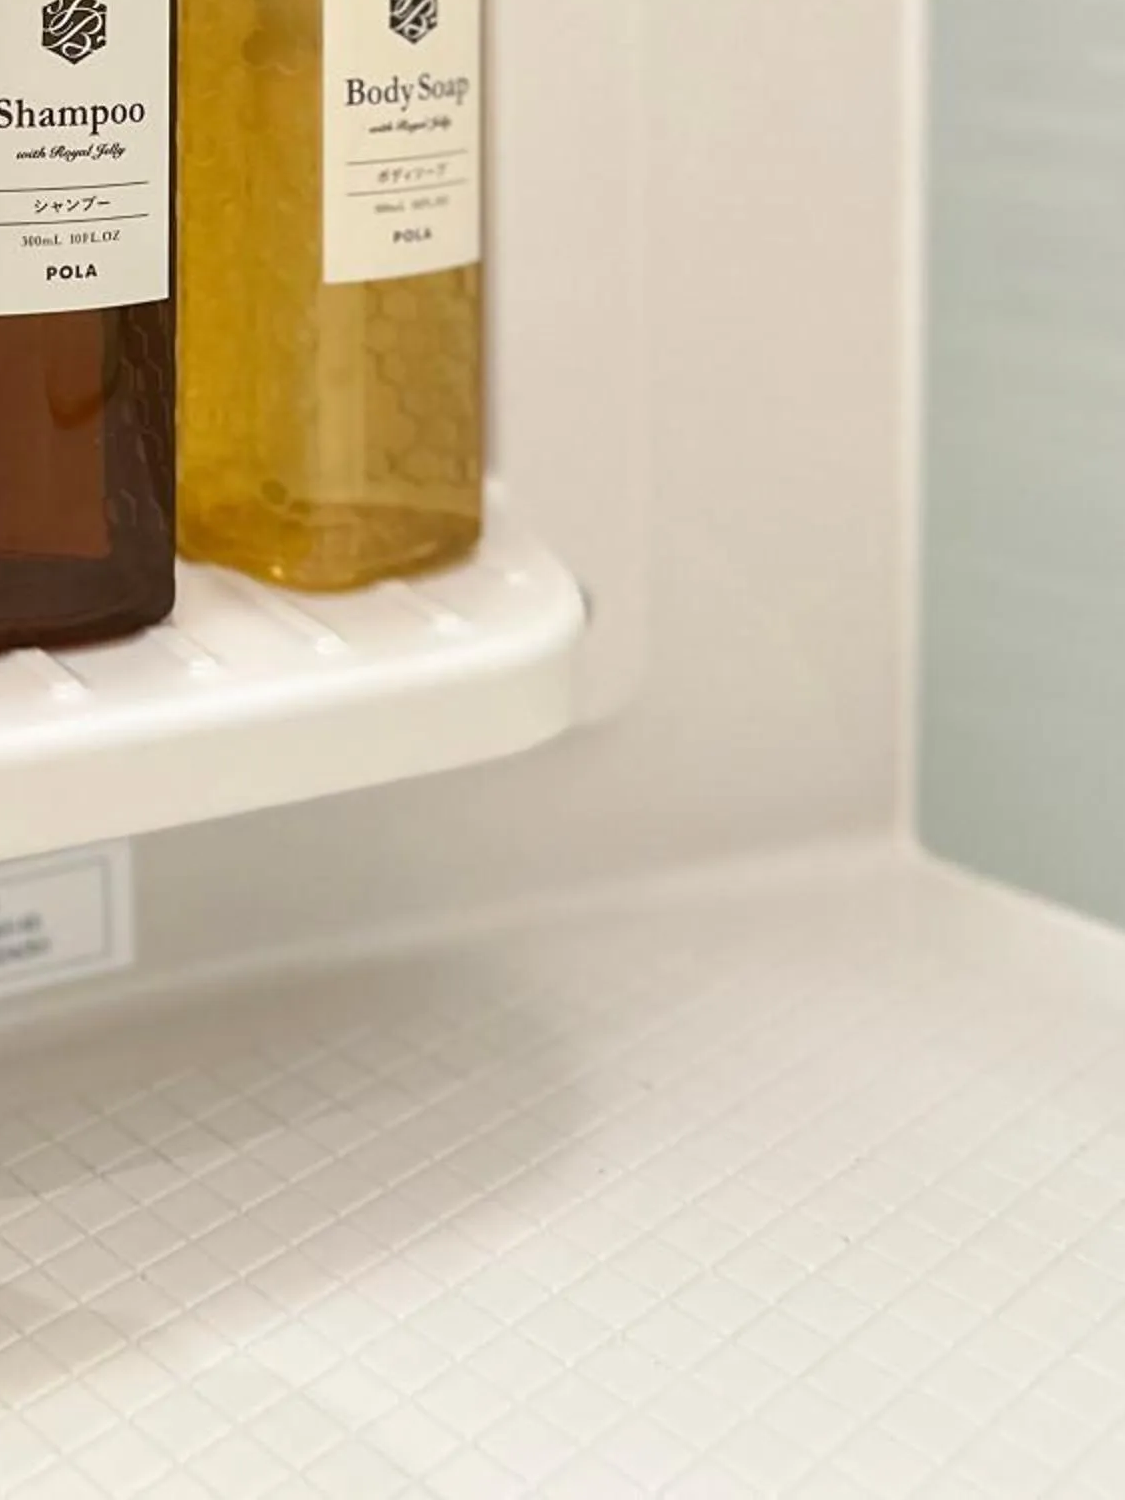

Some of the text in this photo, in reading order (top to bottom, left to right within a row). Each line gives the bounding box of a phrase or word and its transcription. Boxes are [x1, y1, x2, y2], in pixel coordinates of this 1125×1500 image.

[345, 71, 470, 112] Body Soap
[15, 142, 126, 163] with Royal Jelly
[33, 195, 111, 214] シャンプー
[21, 233, 63, 247] 300mL
[392, 227, 433, 244] POLA
[46, 263, 98, 281] POLA
